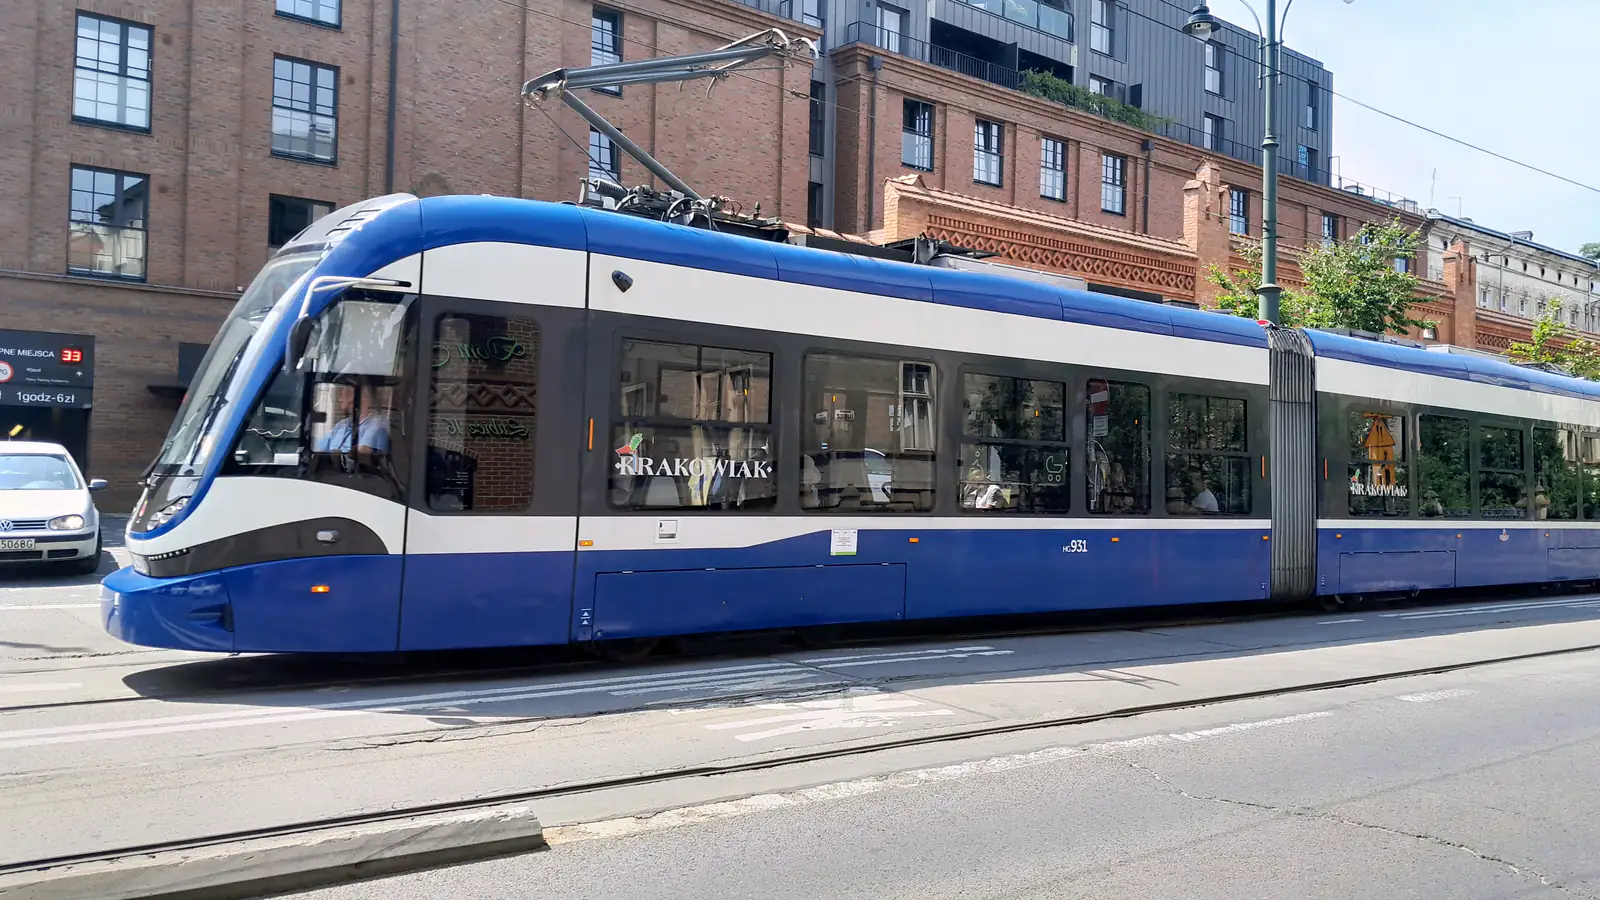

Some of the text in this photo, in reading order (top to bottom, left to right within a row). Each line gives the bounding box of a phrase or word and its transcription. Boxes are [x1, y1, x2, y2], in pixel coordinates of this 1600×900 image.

[17, 349, 54, 358] MIEJSCA
[61, 349, 83, 362] 33
[16, 391, 76, 404] 1godz-6zł
[617, 456, 769, 479] KRAKOWIAK
[1351, 482, 1406, 497] KRAKOWIAK
